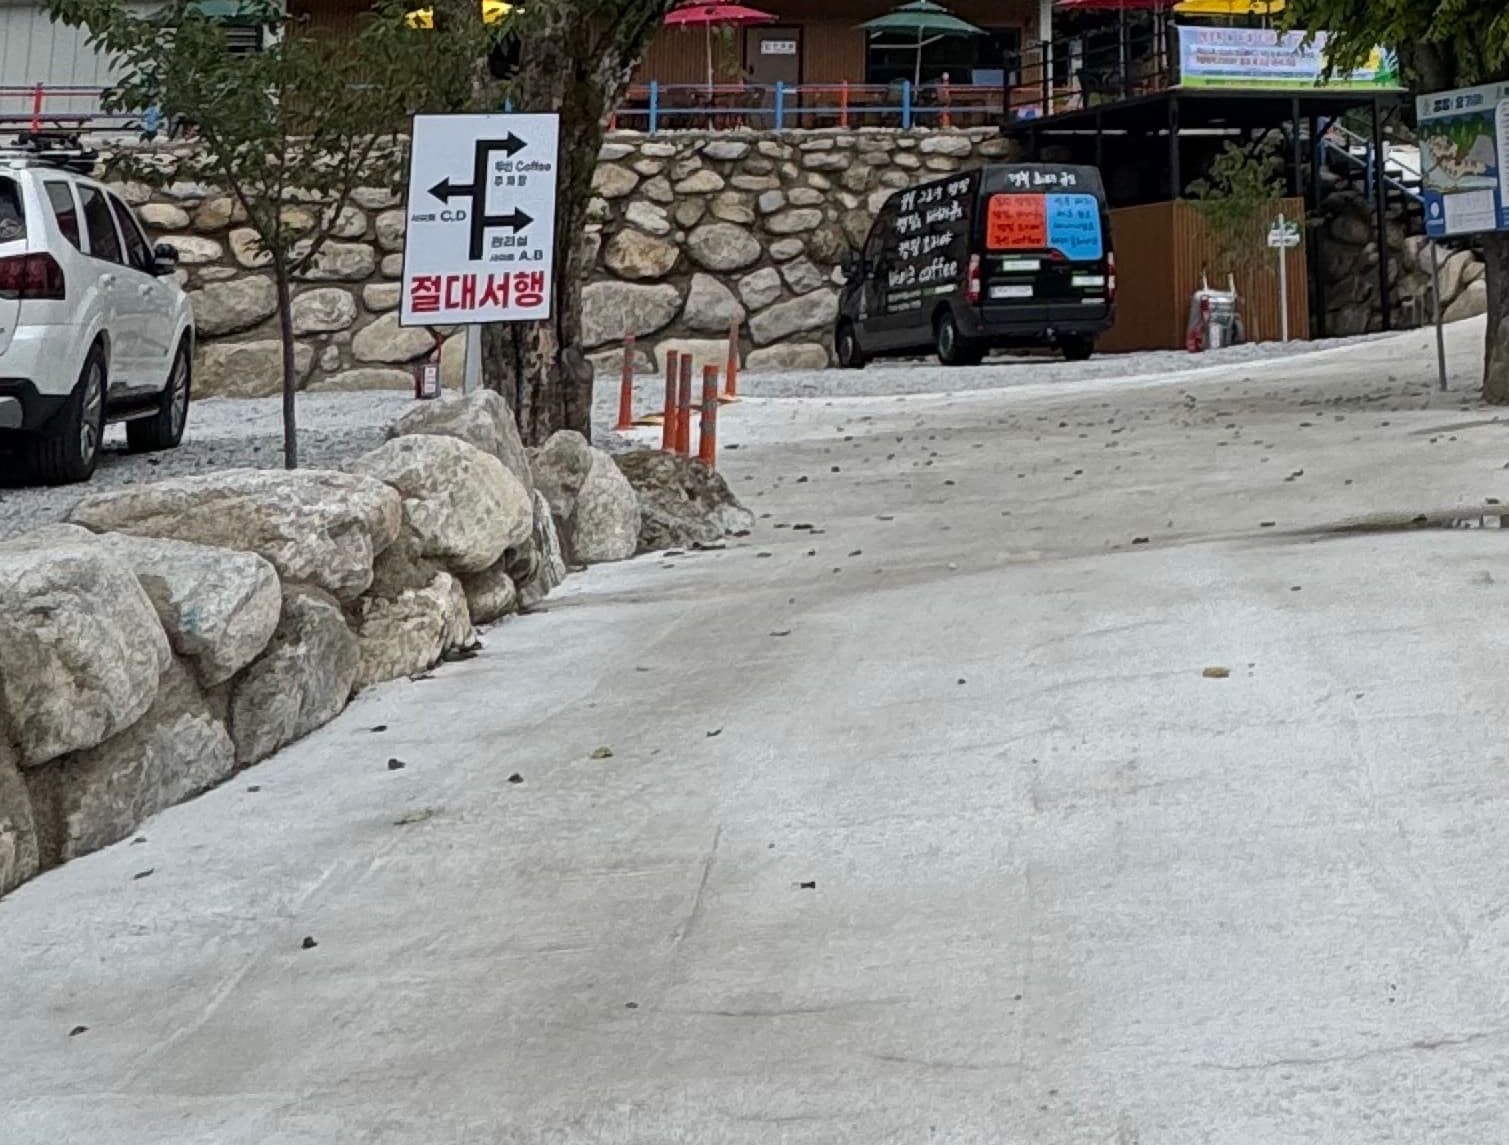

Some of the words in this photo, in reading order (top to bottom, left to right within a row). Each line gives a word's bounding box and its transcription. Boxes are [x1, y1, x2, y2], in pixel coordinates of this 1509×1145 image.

[515, 160, 551, 172] Coffee
[491, 236, 528, 248] 관리실
[411, 270, 545, 313] 절대서행
